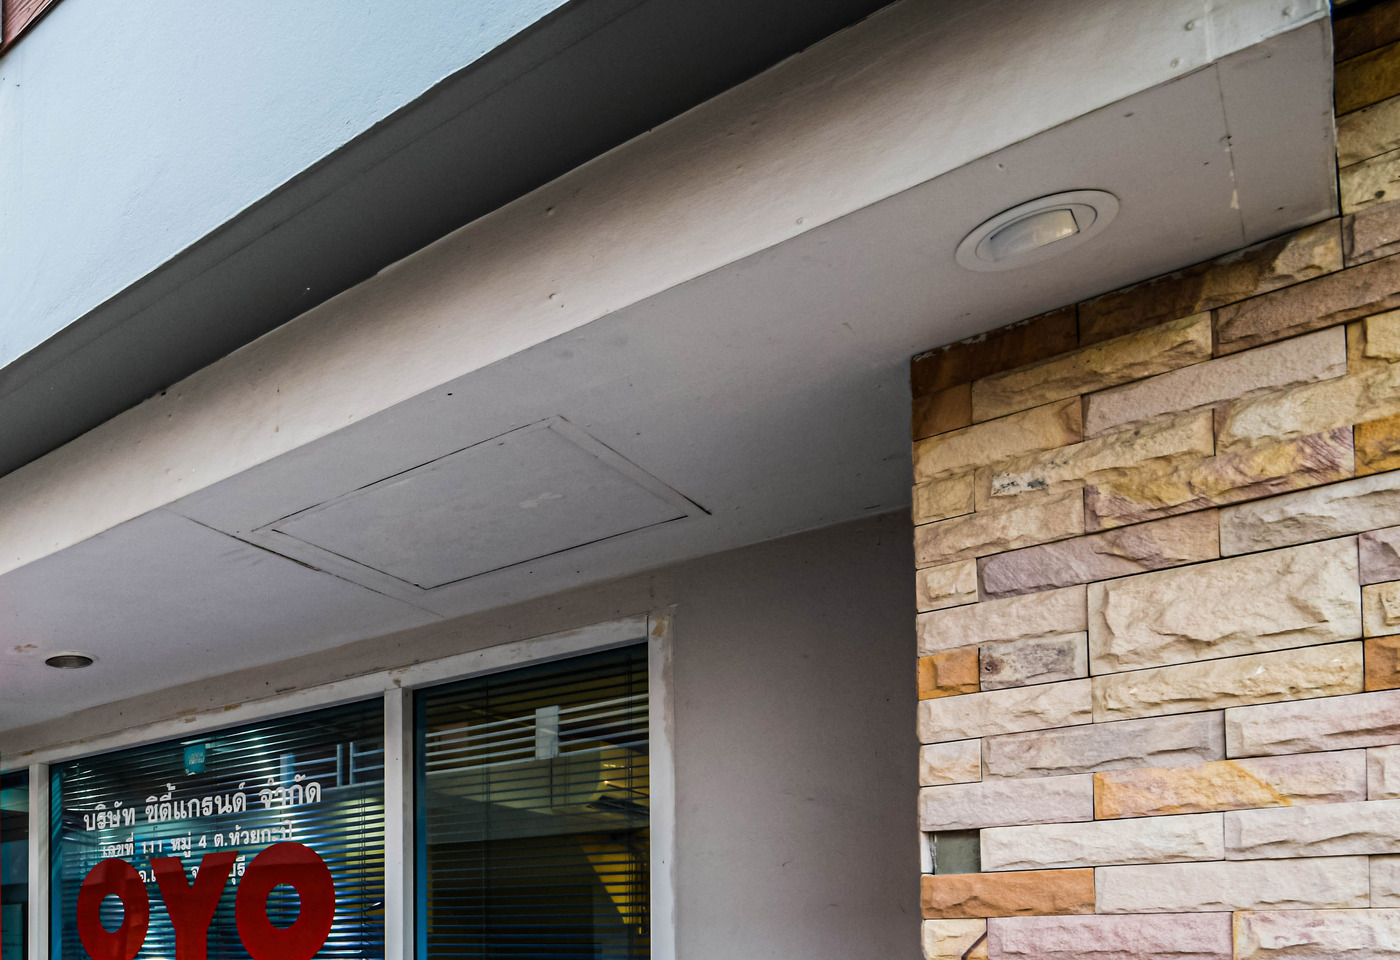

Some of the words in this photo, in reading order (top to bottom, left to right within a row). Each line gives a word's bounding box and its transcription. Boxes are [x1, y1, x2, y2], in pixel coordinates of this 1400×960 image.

[83, 801, 136, 831] บริษัท
[259, 774, 321, 809] จำกัด
[101, 832, 134, 858] เลขที่
[142, 840, 163, 854] 111
[171, 831, 191, 857] หมู่
[198, 834, 207, 848] 4
